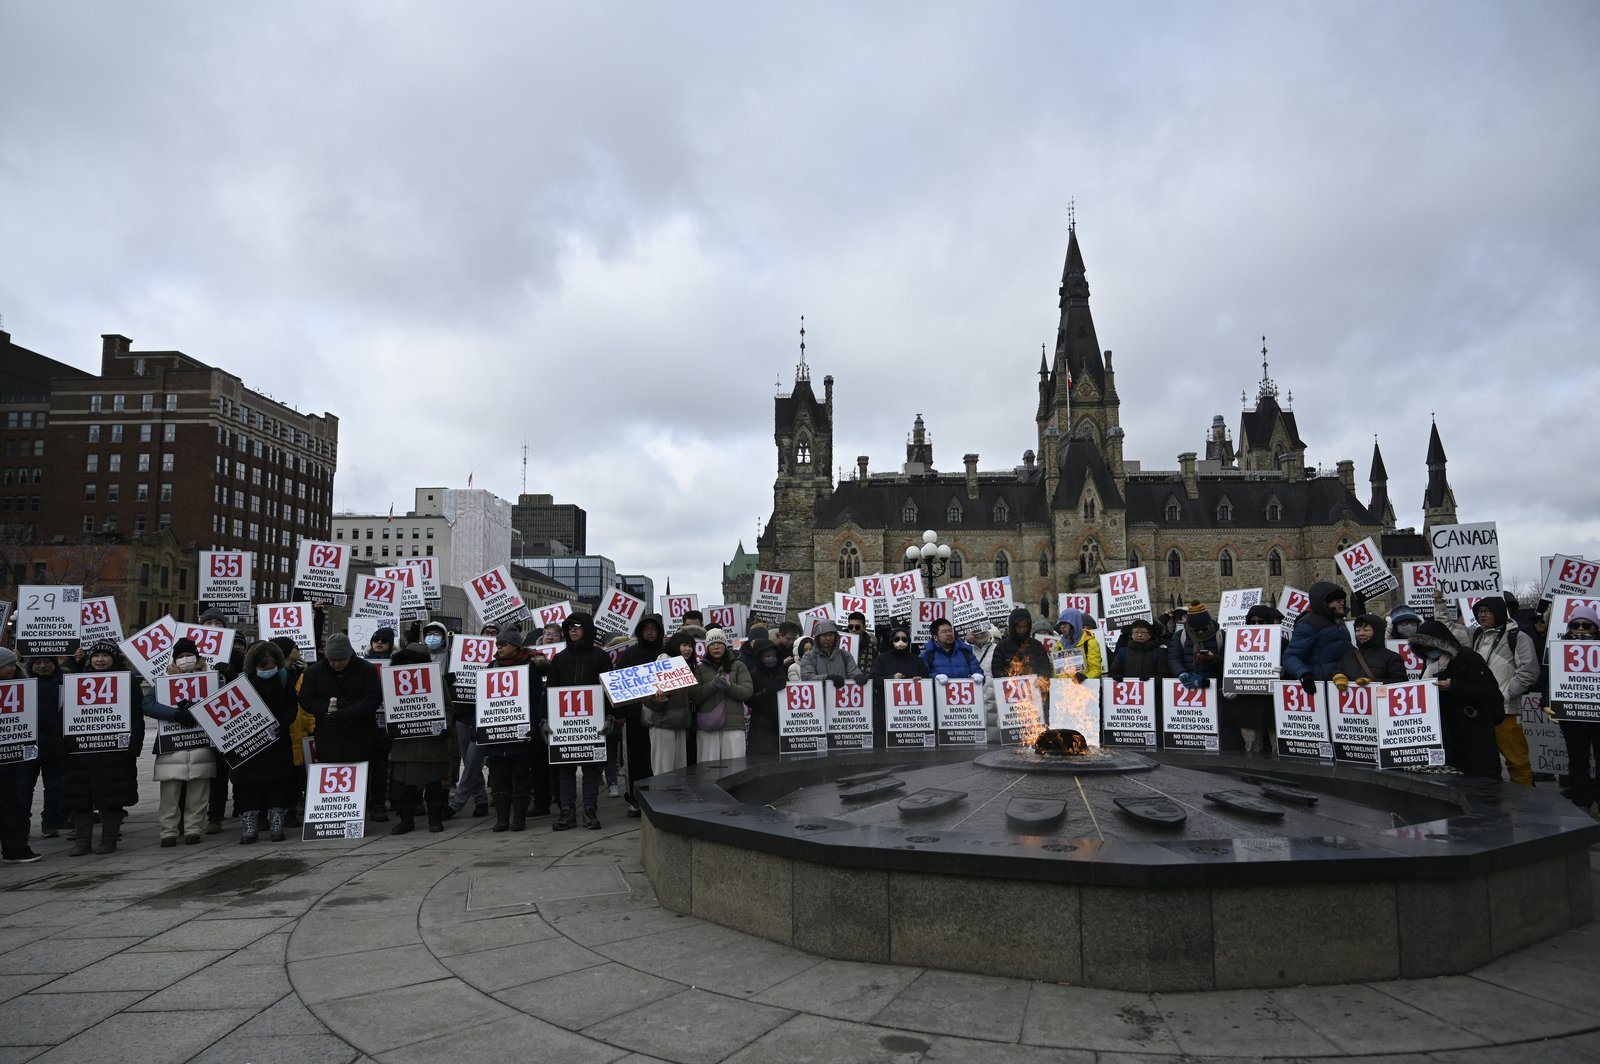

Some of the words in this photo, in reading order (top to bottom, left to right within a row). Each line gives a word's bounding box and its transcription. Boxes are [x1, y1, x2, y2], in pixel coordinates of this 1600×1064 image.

[1433, 529, 1498, 549] CANADA
[213, 555, 239, 577] 55
[312, 545, 337, 568] 62
[1347, 546, 1372, 569] 23
[1435, 556, 1471, 574] WHAT
[1472, 555, 1497, 571] ARE
[764, 576, 780, 593] 17
[1112, 573, 1136, 595] 42
[1437, 579, 1458, 594] YOU
[1461, 572, 1500, 592] DOING?
[1564, 562, 1594, 585] 36
[312, 582, 343, 590] RESPONSE
[367, 580, 391, 602] 22
[477, 573, 501, 598] 13
[865, 580, 884, 596] 34
[893, 575, 913, 596] 23
[949, 584, 970, 604] 30
[984, 580, 1002, 599] 18
[1560, 583, 1587, 595] MONTHS
[27, 593, 55, 610] 29
[612, 595, 635, 618] 31
[672, 599, 690, 617] 68
[845, 596, 863, 612] 72
[922, 602, 944, 621] 30
[1069, 597, 1089, 613] 19
[82, 602, 108, 625] 33
[273, 607, 299, 627] 43
[543, 608, 566, 625] 22
[713, 609, 732, 626] 20
[137, 627, 172, 659] 23
[190, 630, 219, 654] 25
[465, 640, 491, 662] 39
[1239, 629, 1267, 652] 34
[1568, 645, 1600, 672] 30
[397, 669, 428, 695] 81
[609, 667, 639, 682] STOP
[643, 660, 672, 674] THE
[81, 677, 113, 705] 34
[175, 679, 204, 702] 31
[490, 671, 515, 698] 19
[839, 684, 861, 707] 36
[895, 683, 920, 706] 11
[948, 683, 972, 705] 35
[1006, 680, 1029, 703] 20
[1116, 682, 1141, 705] 34
[1177, 684, 1203, 706] 22
[0, 685, 20, 712] 4
[209, 690, 244, 722] 54
[490, 699, 515, 708] MONTHS
[562, 690, 590, 716] 11
[789, 685, 813, 709] 39
[1287, 685, 1311, 712] 31
[1342, 688, 1368, 715] 20
[1393, 687, 1422, 716] 31
[81, 707, 113, 715] MONTHS
[483, 708, 508, 716] WAITING
[494, 714, 526, 723] RESPONSE
[1393, 717, 1423, 727] MONTHS
[86, 723, 126, 731] RESPONSE
[1292, 730, 1324, 738] RESPONSE
[1386, 727, 1415, 736] WAITING
[1417, 725, 1432, 733] FOR
[1382, 737, 1398, 745] IRCC
[1398, 734, 1437, 744] RESPONSE
[1296, 747, 1318, 755] RESULTS
[1403, 754, 1429, 762] RESULTS
[323, 767, 353, 793] 53
[322, 795, 351, 803] MONTHS
[325, 810, 361, 818] RESPONSE
